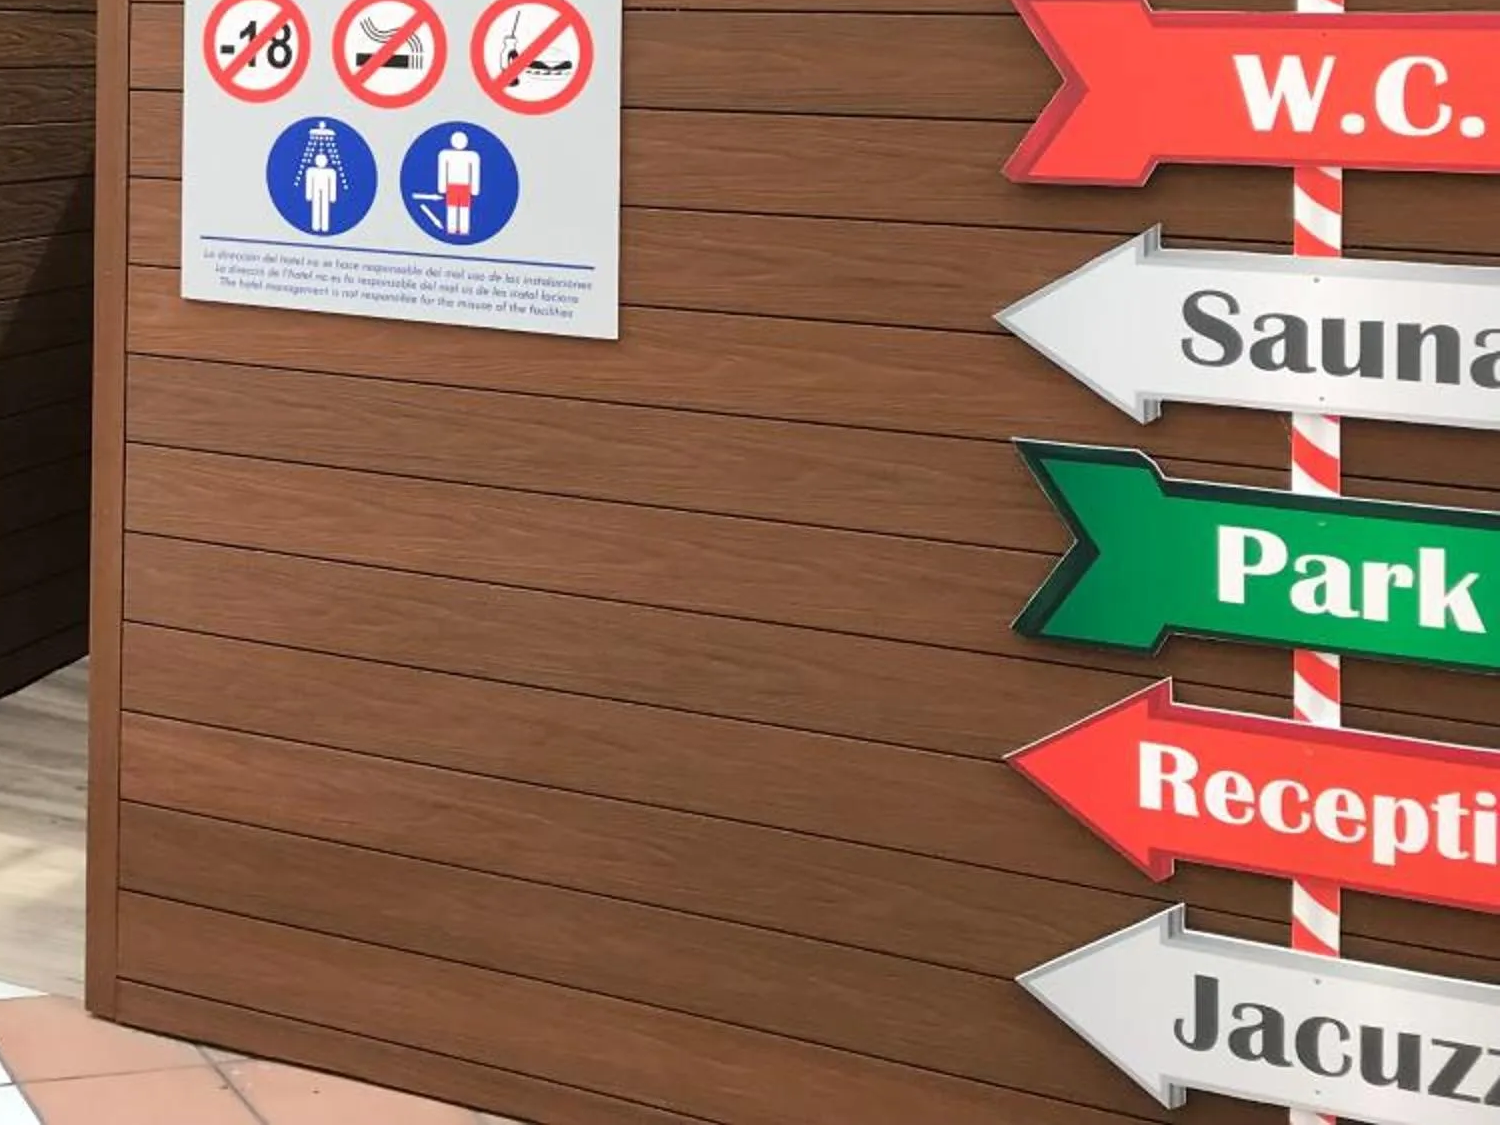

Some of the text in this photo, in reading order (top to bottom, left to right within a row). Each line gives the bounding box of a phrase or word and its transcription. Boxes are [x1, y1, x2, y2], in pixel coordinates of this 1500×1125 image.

[1232, 54, 1487, 138] W.C.
[220, 277, 236, 288] The
[239, 279, 262, 290] hotel
[266, 282, 328, 297] management
[342, 289, 358, 299] not
[420, 295, 435, 305] for
[438, 296, 454, 307] the
[509, 302, 526, 313] the
[280, 254, 304, 266] hotel
[336, 259, 358, 271] hace
[426, 266, 442, 278] del
[420, 280, 436, 291] del
[1215, 524, 1488, 636] Park
[1138, 740, 1498, 867] Recepti
